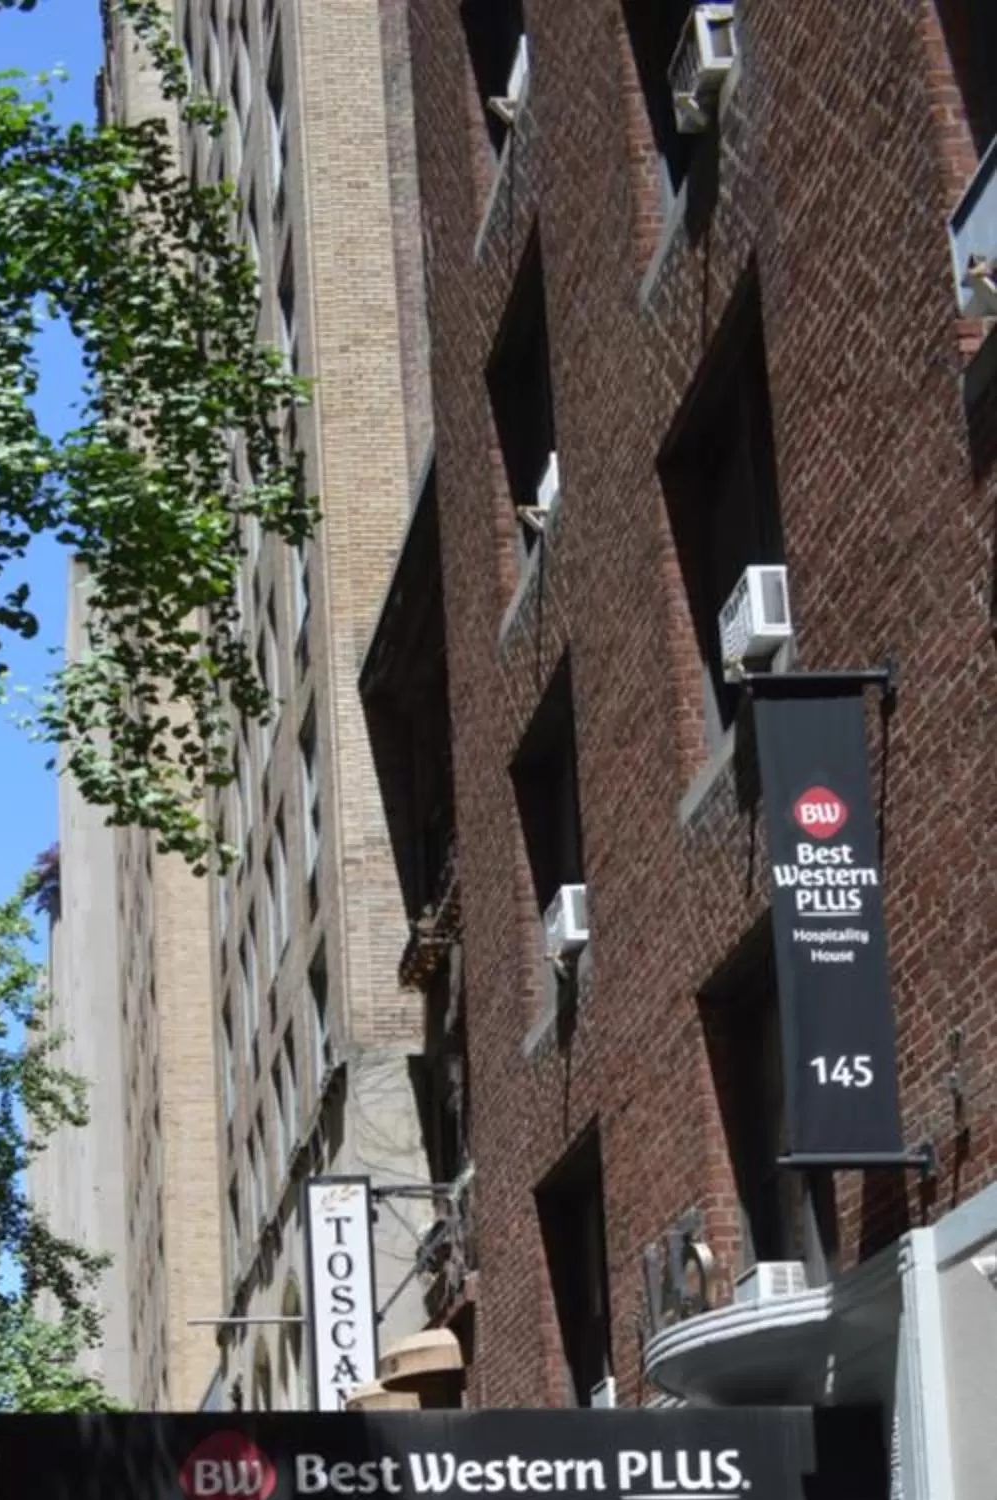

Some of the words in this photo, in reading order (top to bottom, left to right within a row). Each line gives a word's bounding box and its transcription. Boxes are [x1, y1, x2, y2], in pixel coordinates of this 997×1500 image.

[800, 803, 841, 824] BW
[796, 843, 854, 865] Best
[773, 864, 879, 887] Western
[795, 888, 863, 911] PLUS
[792, 928, 870, 944] Hospitality
[810, 948, 855, 963] House
[810, 1055, 873, 1087] 145
[194, 1459, 264, 1496] BW
[295, 1453, 403, 1494] Best
[408, 1452, 607, 1493] Western
